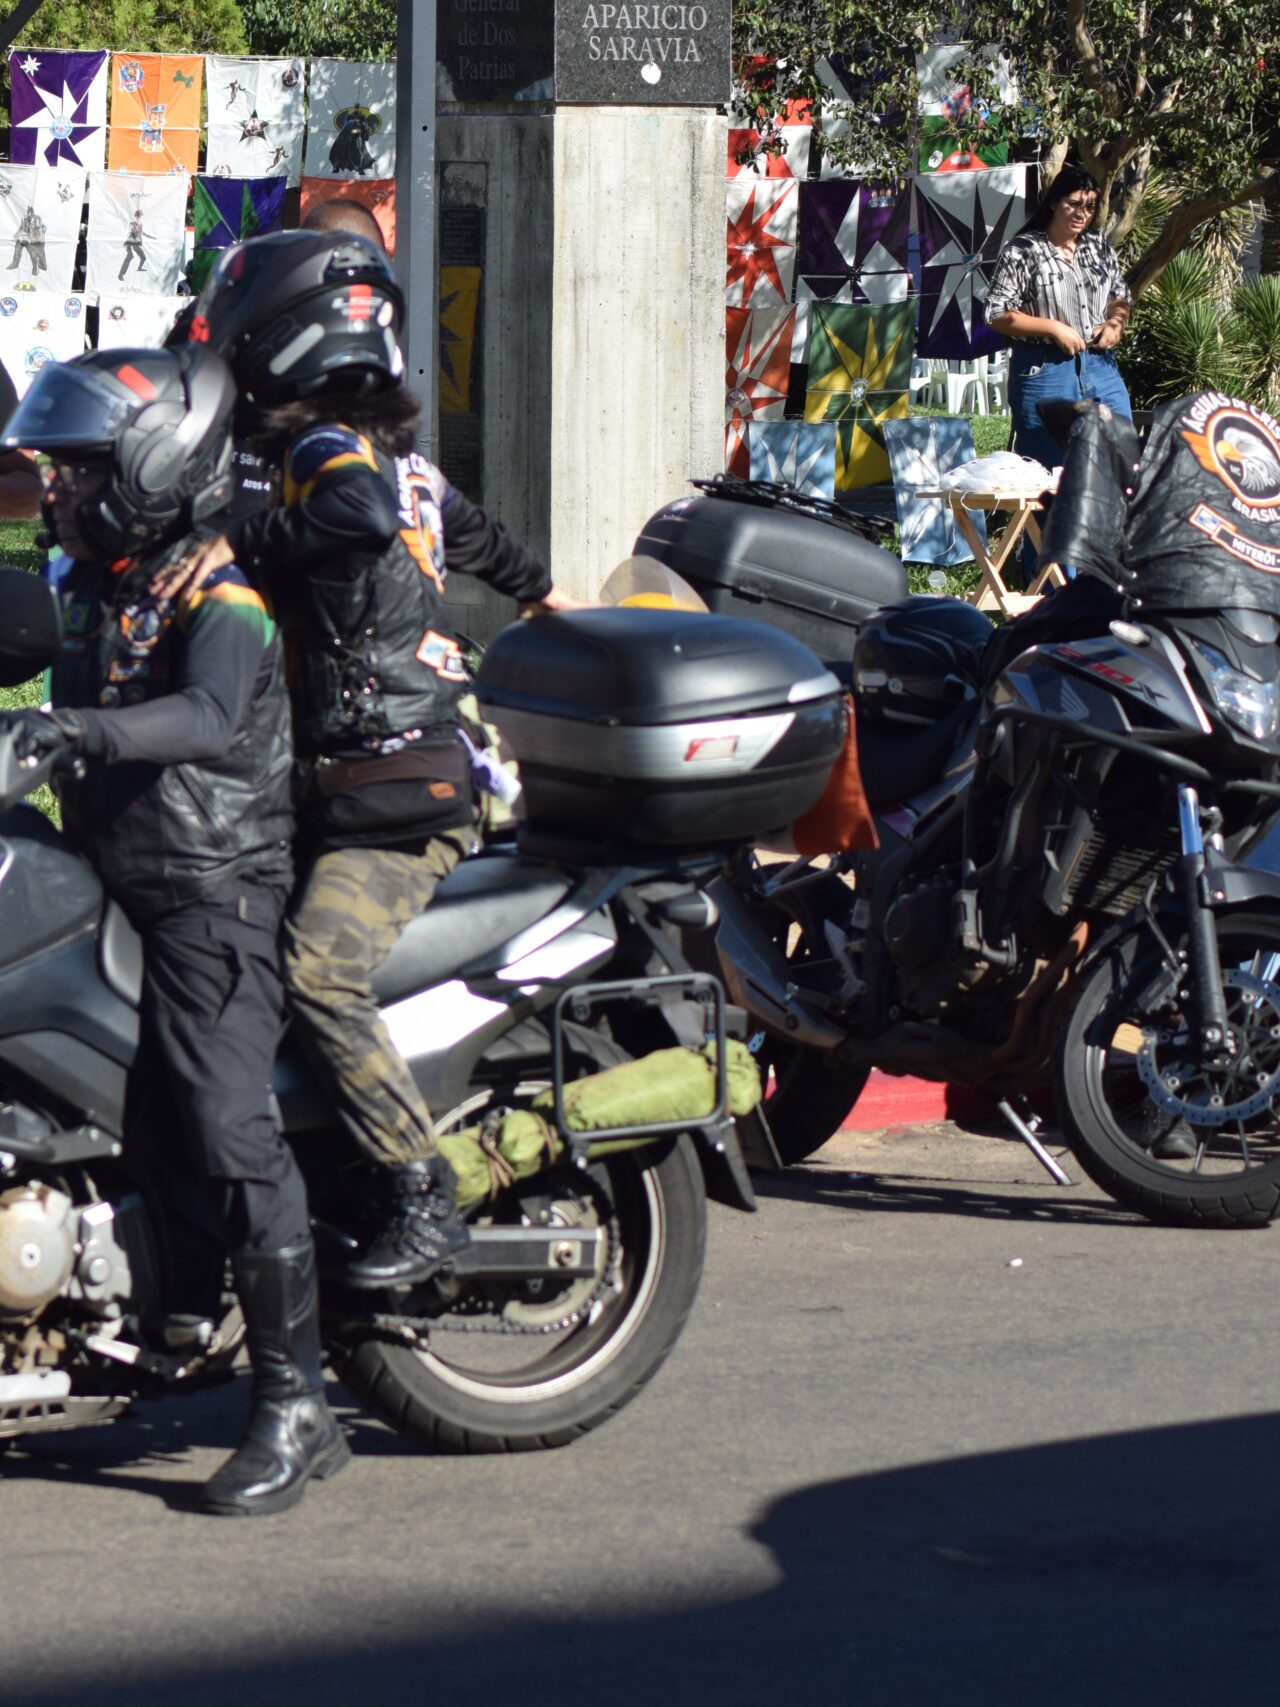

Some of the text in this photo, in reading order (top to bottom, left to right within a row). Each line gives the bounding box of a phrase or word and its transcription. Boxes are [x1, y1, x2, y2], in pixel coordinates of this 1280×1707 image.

[582, 4, 707, 30] APARICIO
[458, 22, 516, 46] de Dos
[588, 35, 701, 62] SARAVIA
[457, 56, 516, 80] Patrias
[1232, 398, 1248, 411] DE
